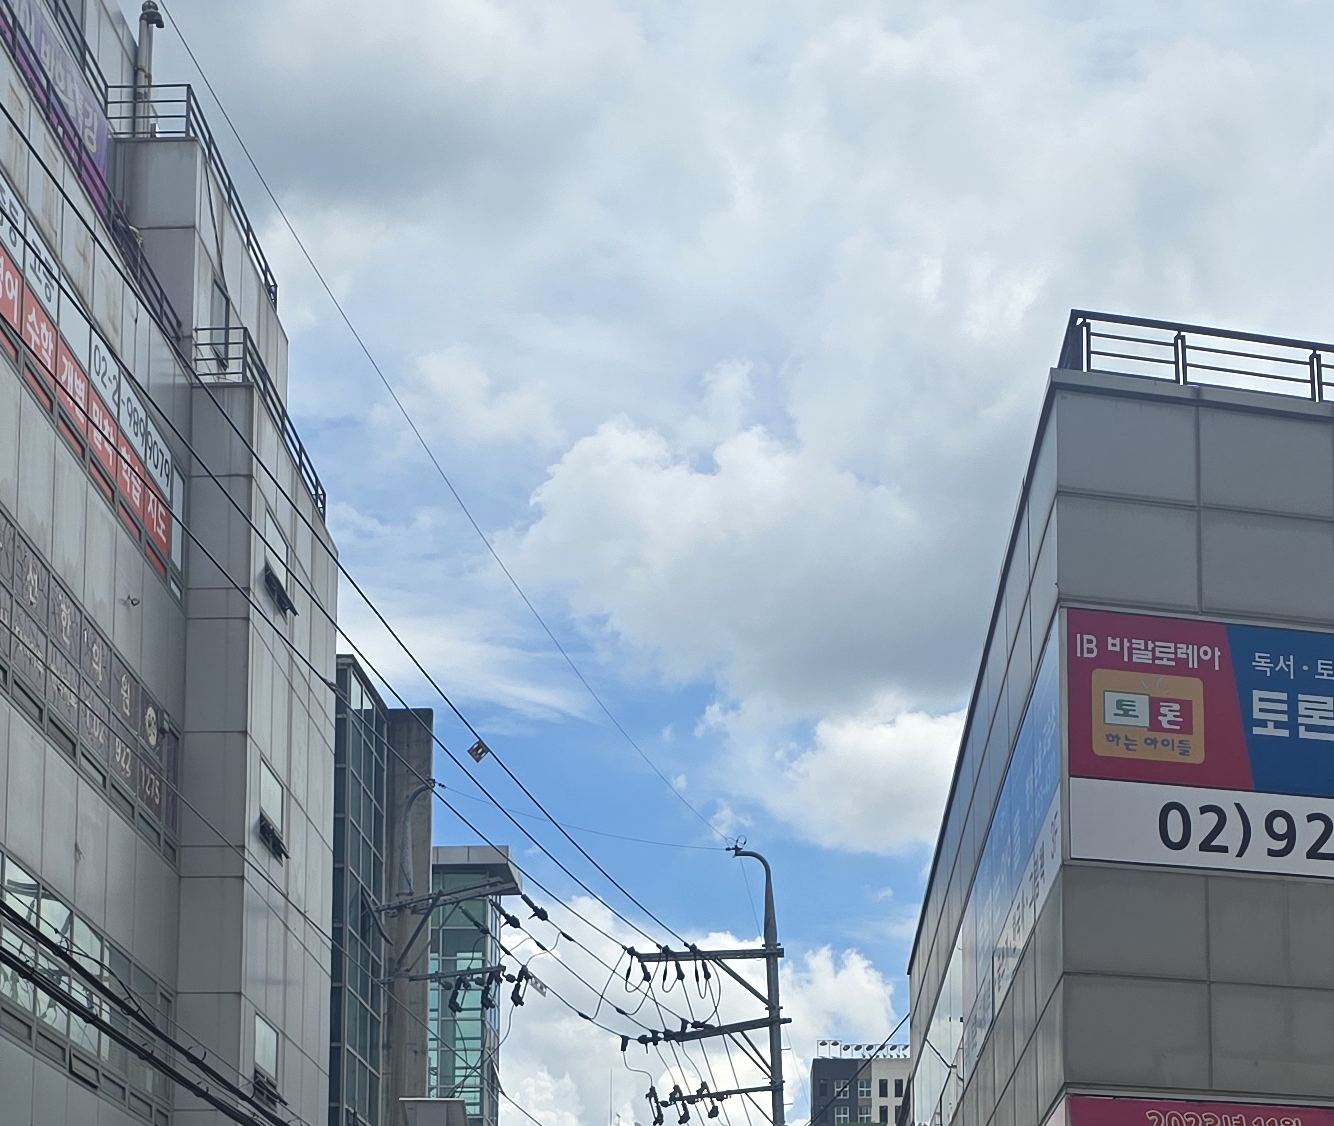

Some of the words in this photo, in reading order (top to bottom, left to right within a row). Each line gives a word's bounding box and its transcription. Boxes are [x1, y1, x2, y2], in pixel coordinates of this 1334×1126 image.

[27, 306, 53, 369] 수학
[1077, 634, 1098, 658] IB
[1108, 636, 1220, 671] 바칼로레아
[1252, 652, 1294, 679] 독서
